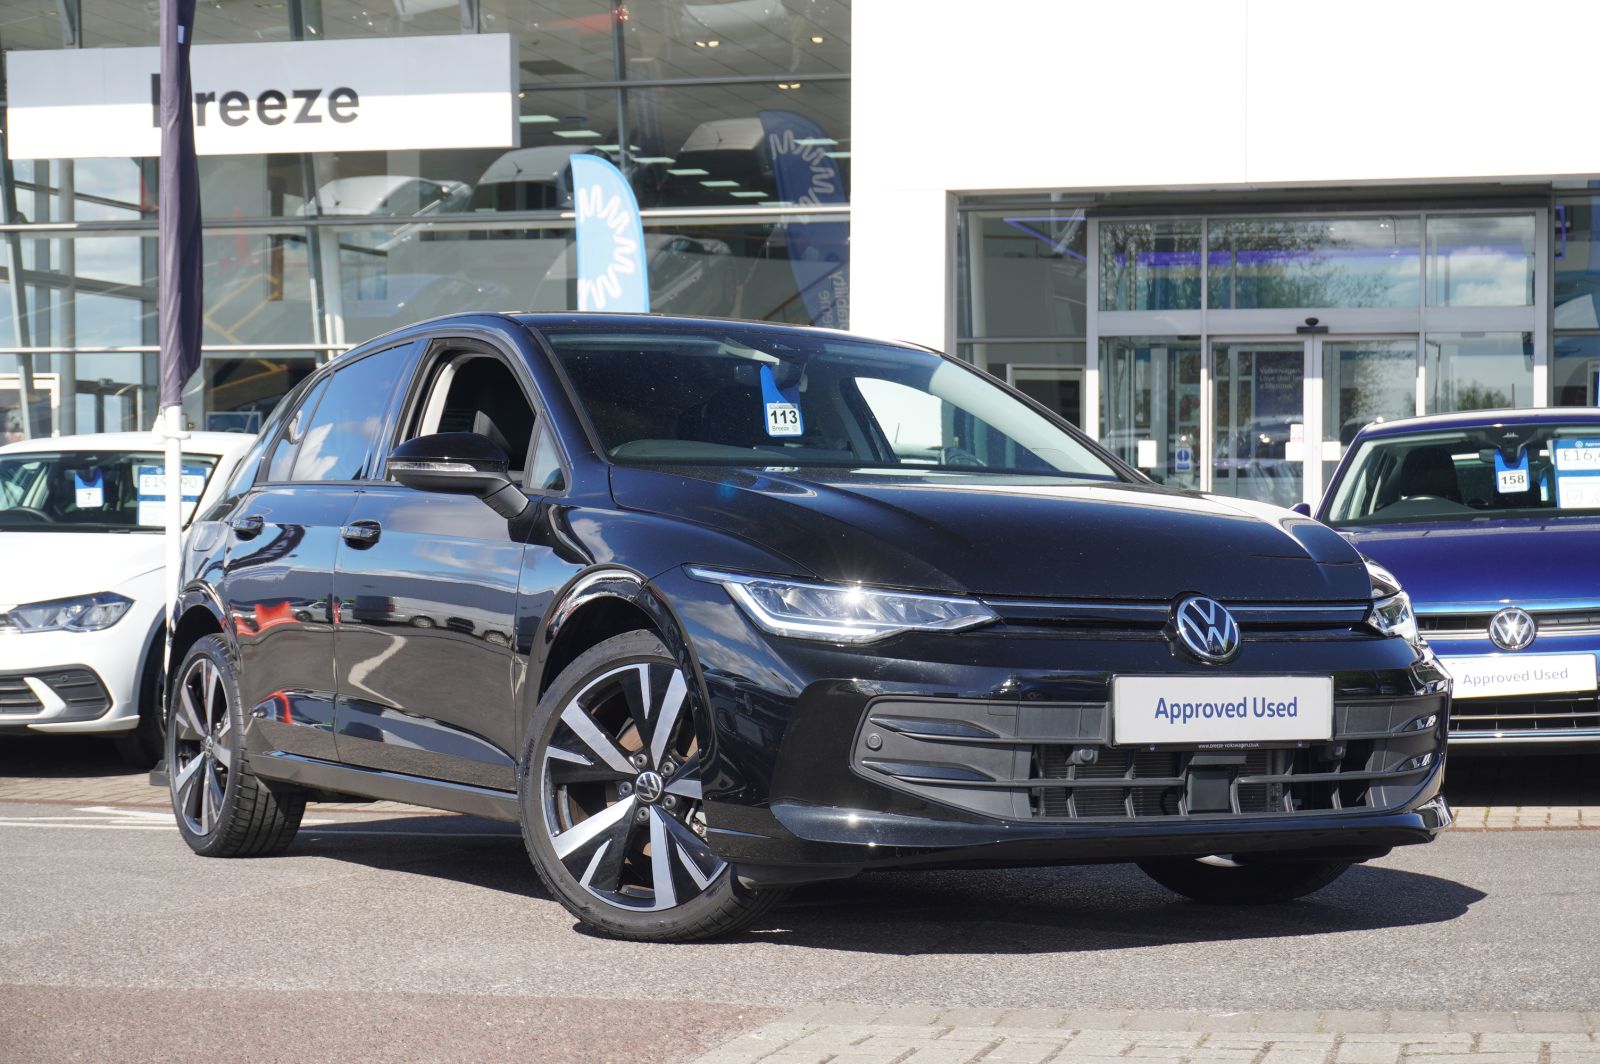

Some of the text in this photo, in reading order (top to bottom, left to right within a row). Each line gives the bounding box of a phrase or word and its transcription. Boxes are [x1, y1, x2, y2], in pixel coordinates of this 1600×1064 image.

[771, 410, 798, 424] 113
[1501, 474, 1525, 485] 158
[85, 492, 92, 500] 7
[1463, 667, 1569, 687] Approved Used
[1154, 696, 1298, 725] Approved Used
